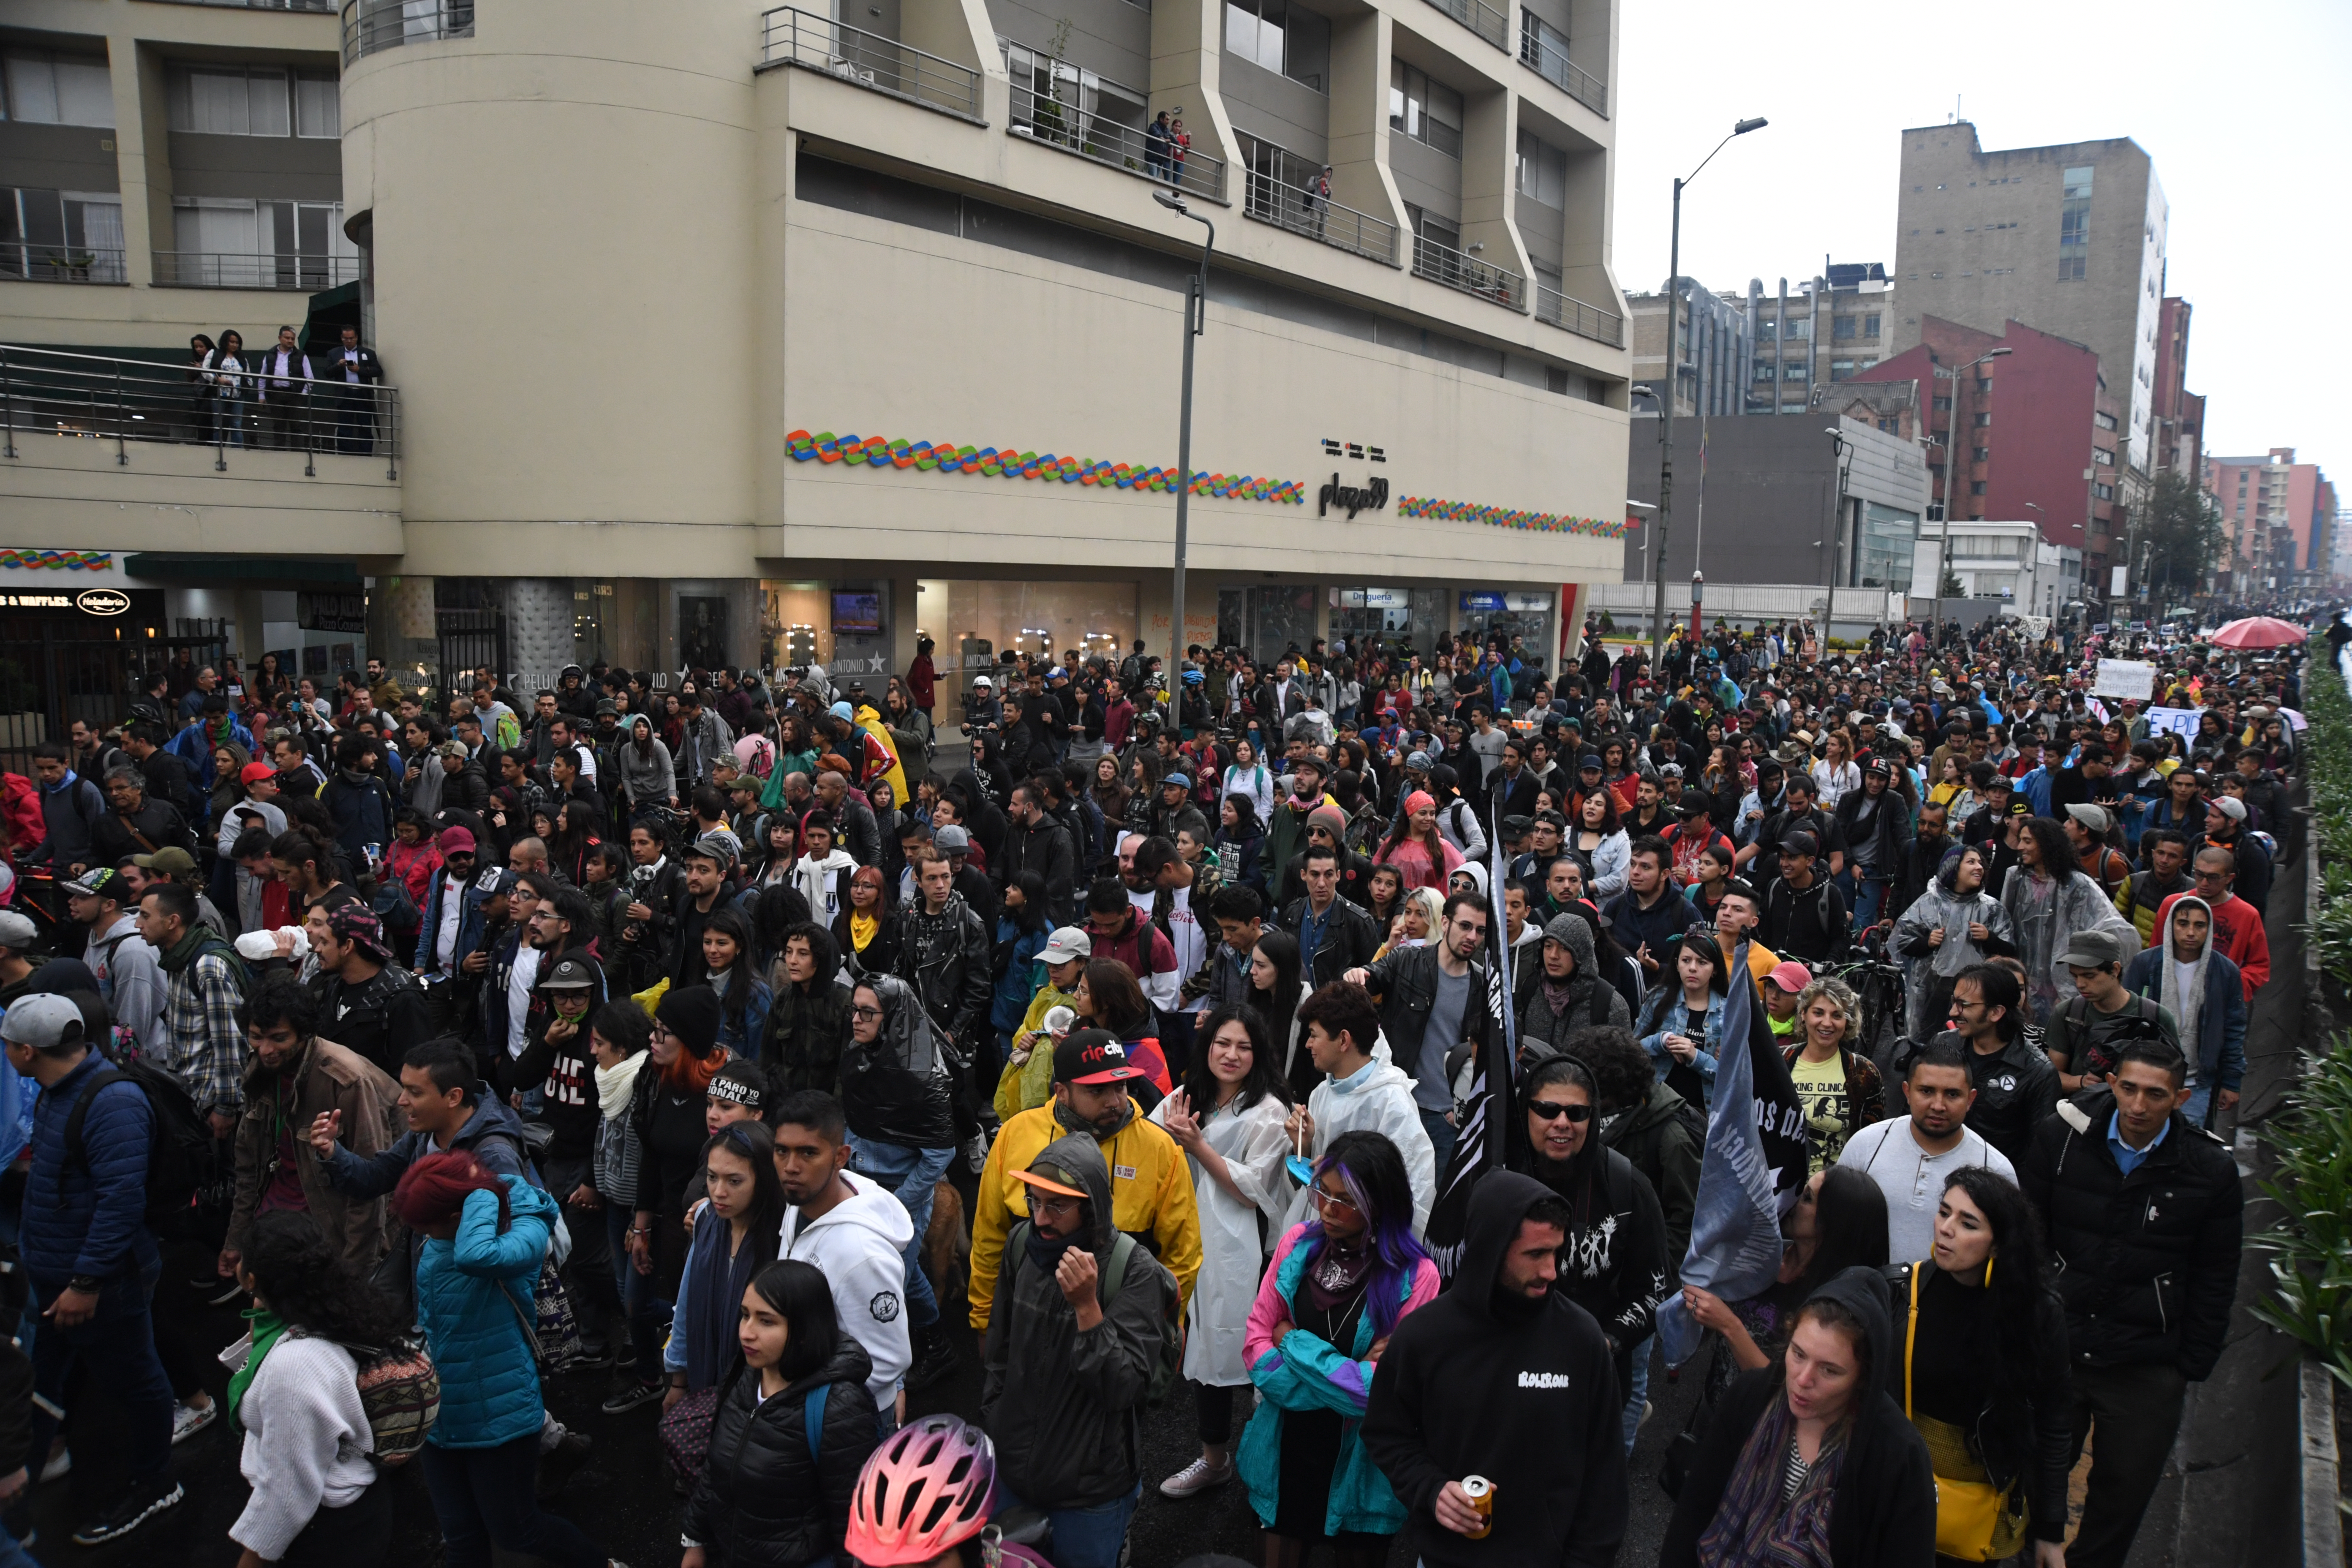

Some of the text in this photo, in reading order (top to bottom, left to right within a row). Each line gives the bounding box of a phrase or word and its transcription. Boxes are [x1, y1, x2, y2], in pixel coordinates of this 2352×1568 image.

[965, 653, 992, 669] ANTONIO
[718, 1079, 747, 1095] PARO
[749, 1089, 760, 1098] YO
